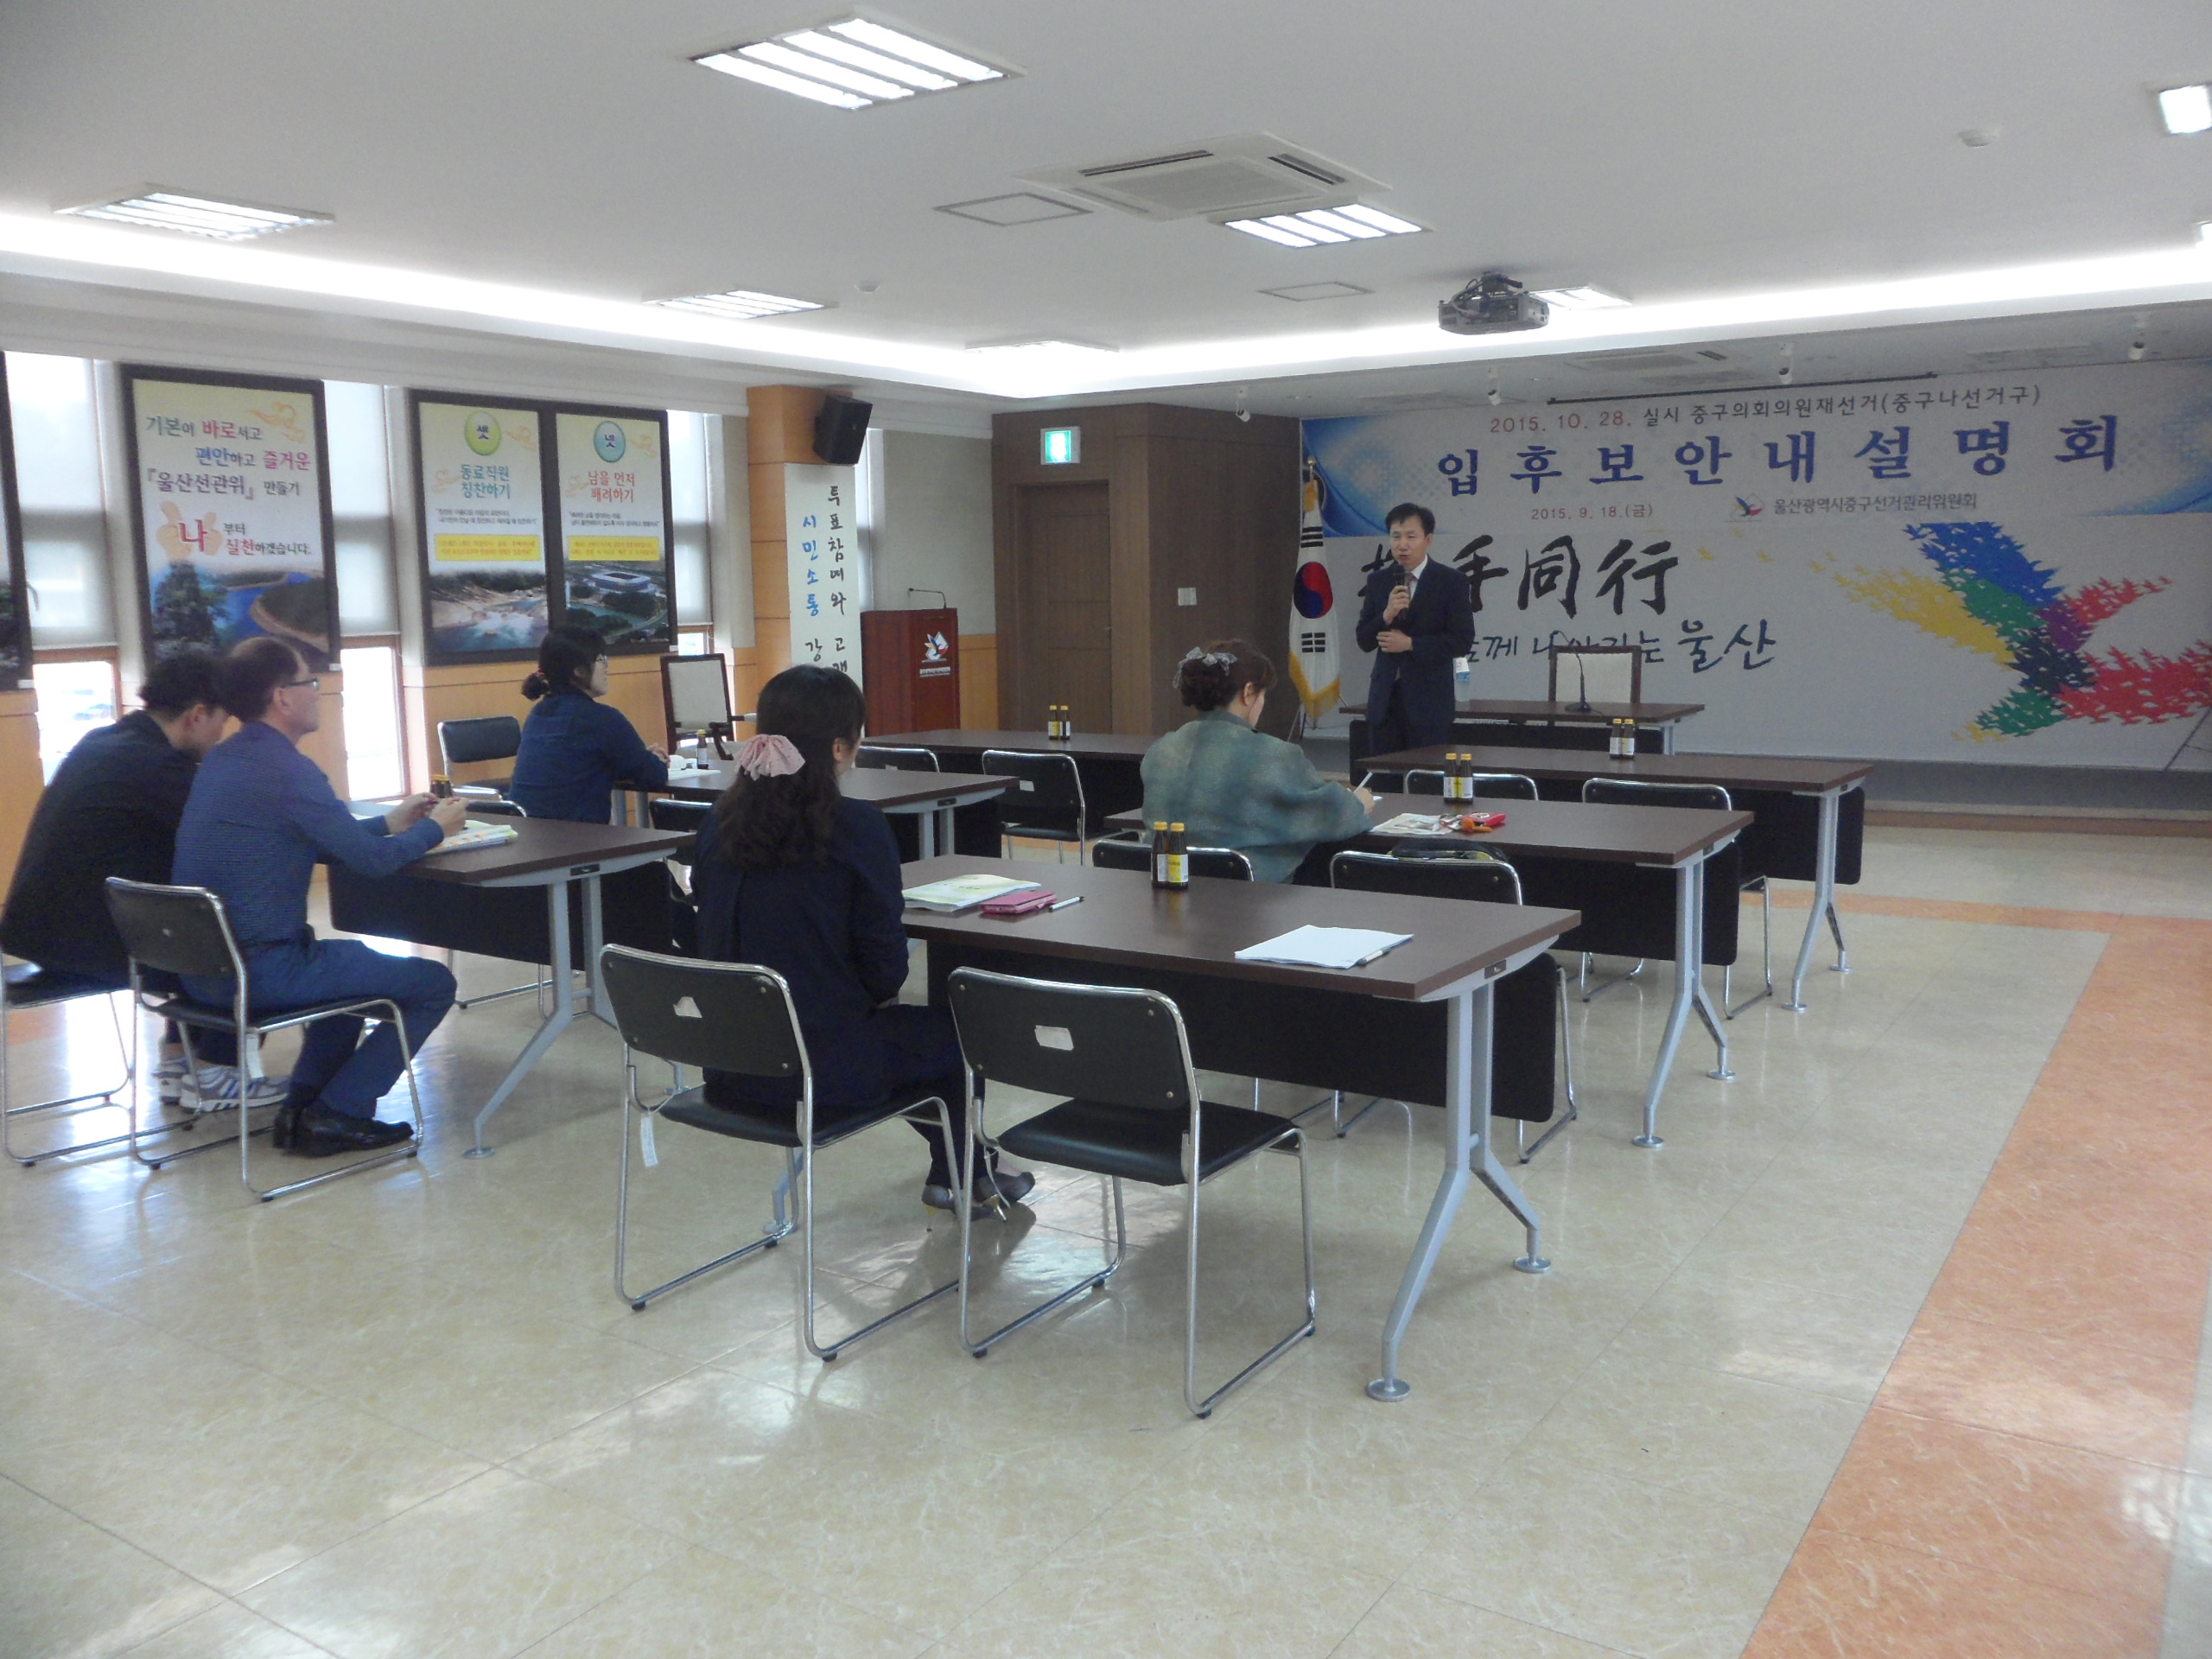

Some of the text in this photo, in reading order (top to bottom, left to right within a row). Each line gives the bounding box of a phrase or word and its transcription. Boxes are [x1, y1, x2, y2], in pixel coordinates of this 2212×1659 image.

[145, 416, 263, 441] 기본이 바로서고
[1490, 416, 1546, 433] 2015.
[1558, 412, 1588, 429] 10.
[1599, 410, 1631, 427] 28.
[1643, 406, 1679, 427] 실시
[604, 434, 616, 448] 넷
[195, 447, 311, 471] 편안하고 즐거운
[461, 464, 510, 481] 동료직원
[588, 470, 635, 486] 남을 먼저
[264, 480, 301, 496] 만들기
[461, 481, 512, 499] 칭찬하기
[591, 487, 634, 503] 배려하기
[1531, 508, 1572, 520] 2015.
[1579, 506, 1594, 519] 9.
[1773, 493, 1977, 516] 울산광역시중구선거관리위원회
[179, 518, 245, 552] 나 부터
[226, 538, 312, 556] 실천하겠습니다.
[801, 514, 820, 617] 시민소통
[1357, 534, 1679, 619] 手同行
[1678, 619, 1776, 673] 울산
